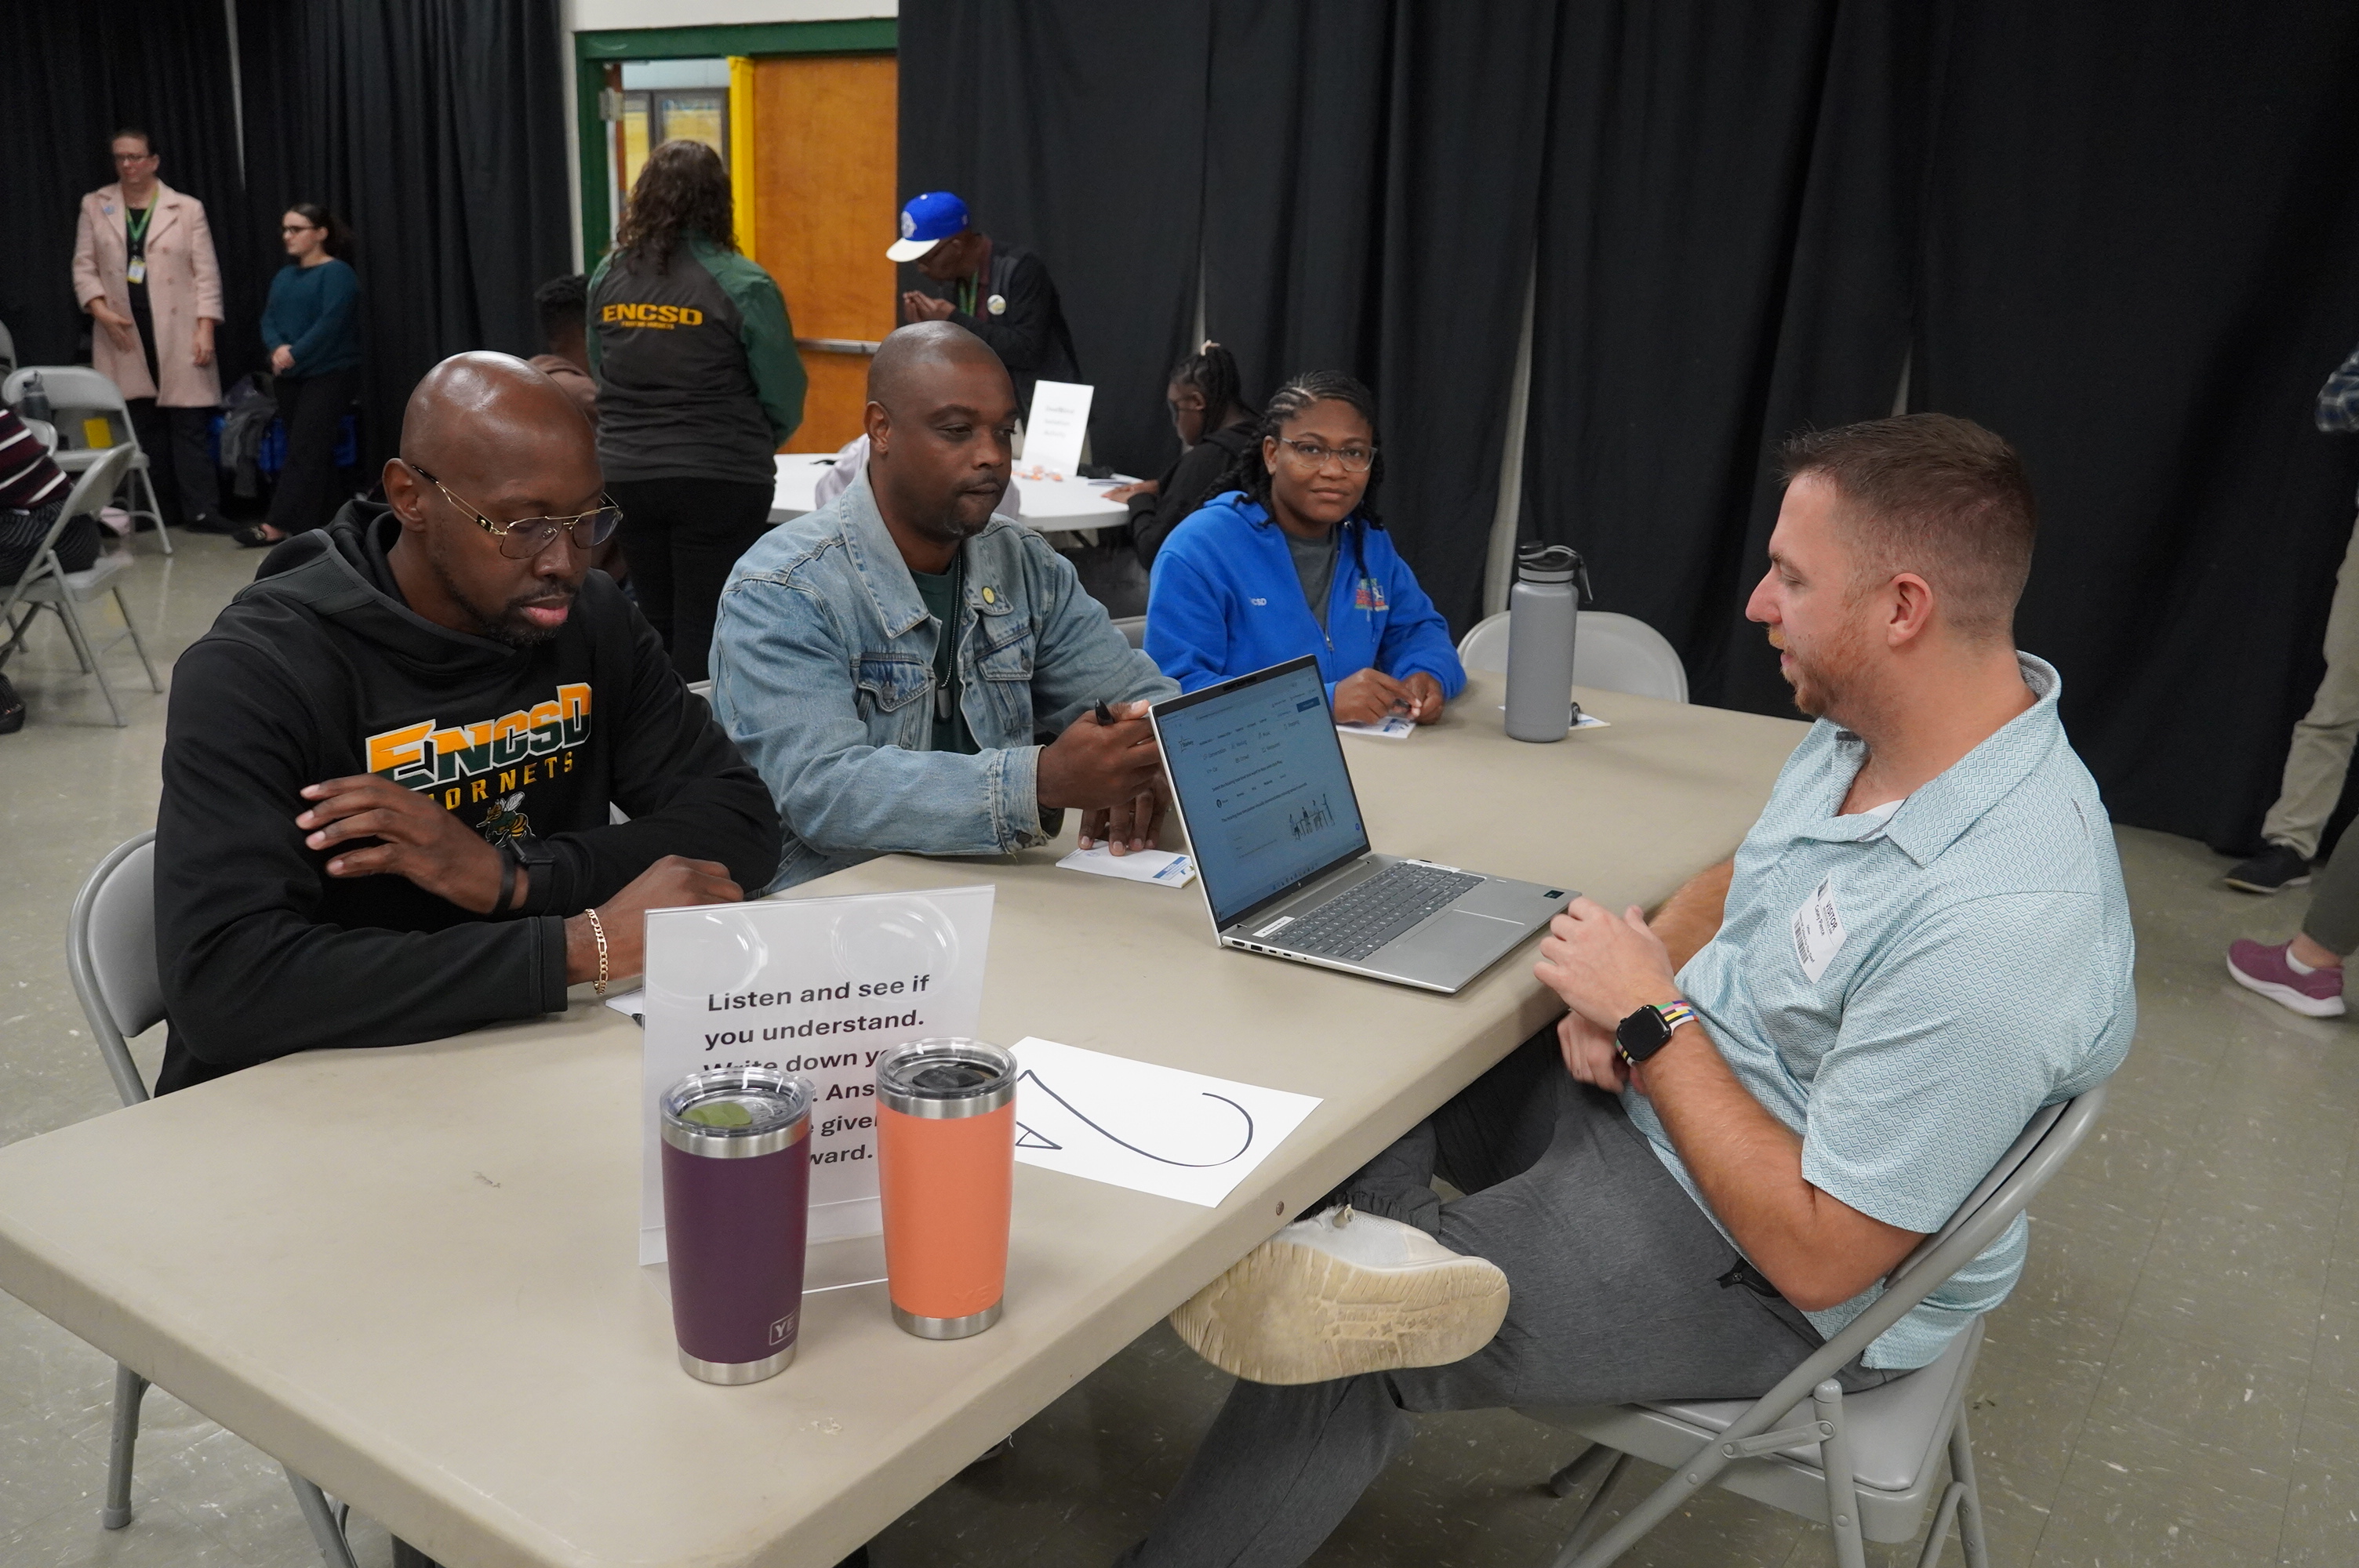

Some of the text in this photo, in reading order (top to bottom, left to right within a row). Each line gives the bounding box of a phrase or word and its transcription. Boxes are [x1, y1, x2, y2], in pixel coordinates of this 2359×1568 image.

[602, 303, 703, 326] ENCSD
[365, 682, 592, 791] ENCSD
[428, 751, 573, 811] ORNETS
[1826, 900, 1838, 930] VISITOR
[708, 975, 930, 1011] Listen and see if
[705, 1009, 924, 1051] you understand.
[786, 1053, 857, 1073] down
